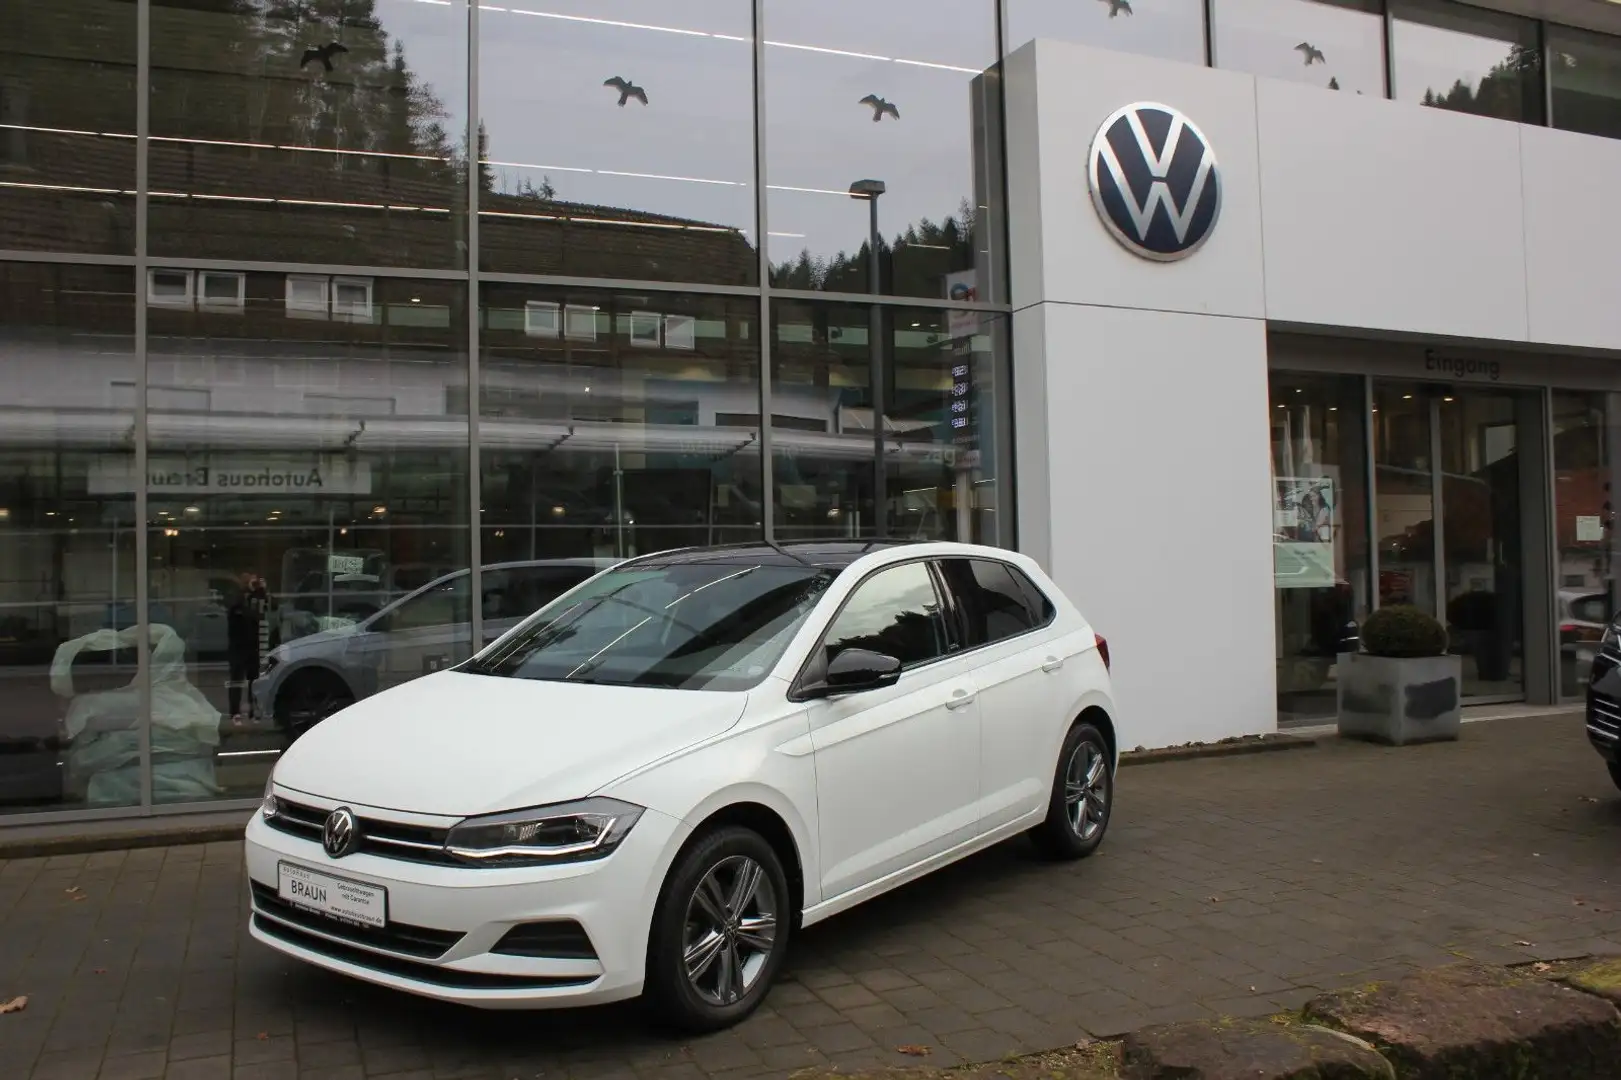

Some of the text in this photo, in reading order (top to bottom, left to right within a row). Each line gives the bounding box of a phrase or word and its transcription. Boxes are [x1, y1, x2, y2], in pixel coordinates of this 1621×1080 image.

[1424, 348, 1500, 381] Eingang
[291, 879, 327, 903] BRAUN
[337, 882, 375, 898] Gebrauchtwagen
